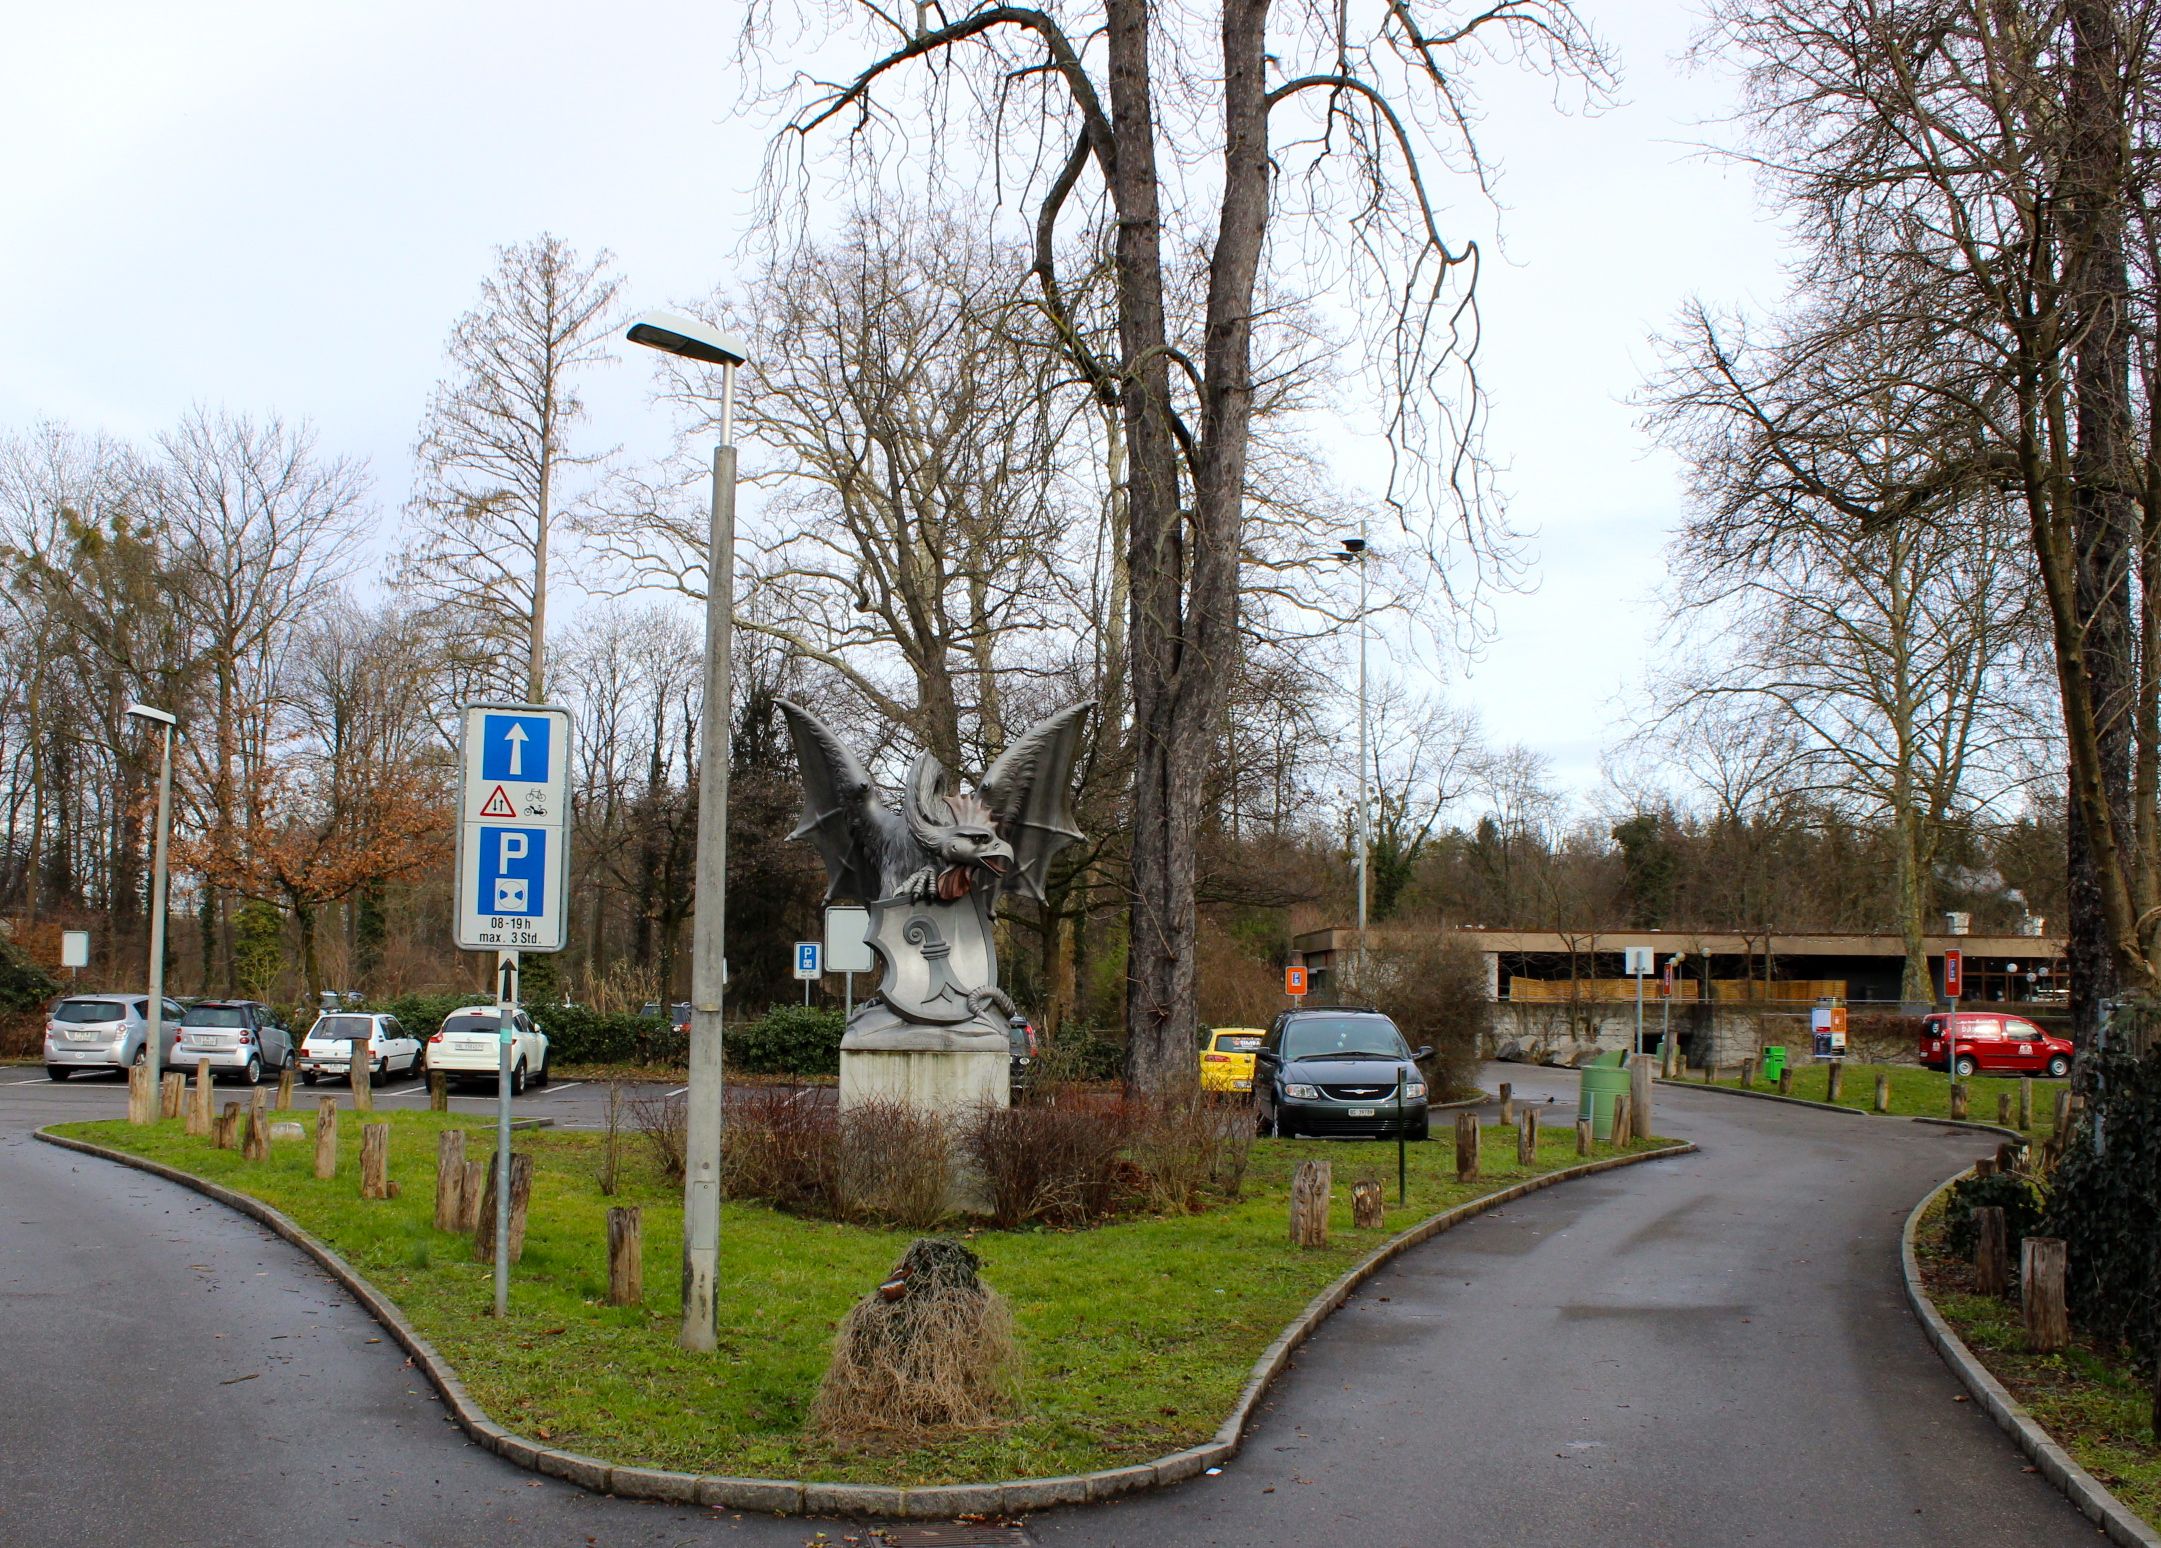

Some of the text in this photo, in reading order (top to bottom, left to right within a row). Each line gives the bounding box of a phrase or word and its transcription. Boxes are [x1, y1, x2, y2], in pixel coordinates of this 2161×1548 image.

[499, 832, 529, 875] P
[479, 932, 541, 945] max. 3 Std.
[804, 947, 812, 958] P
